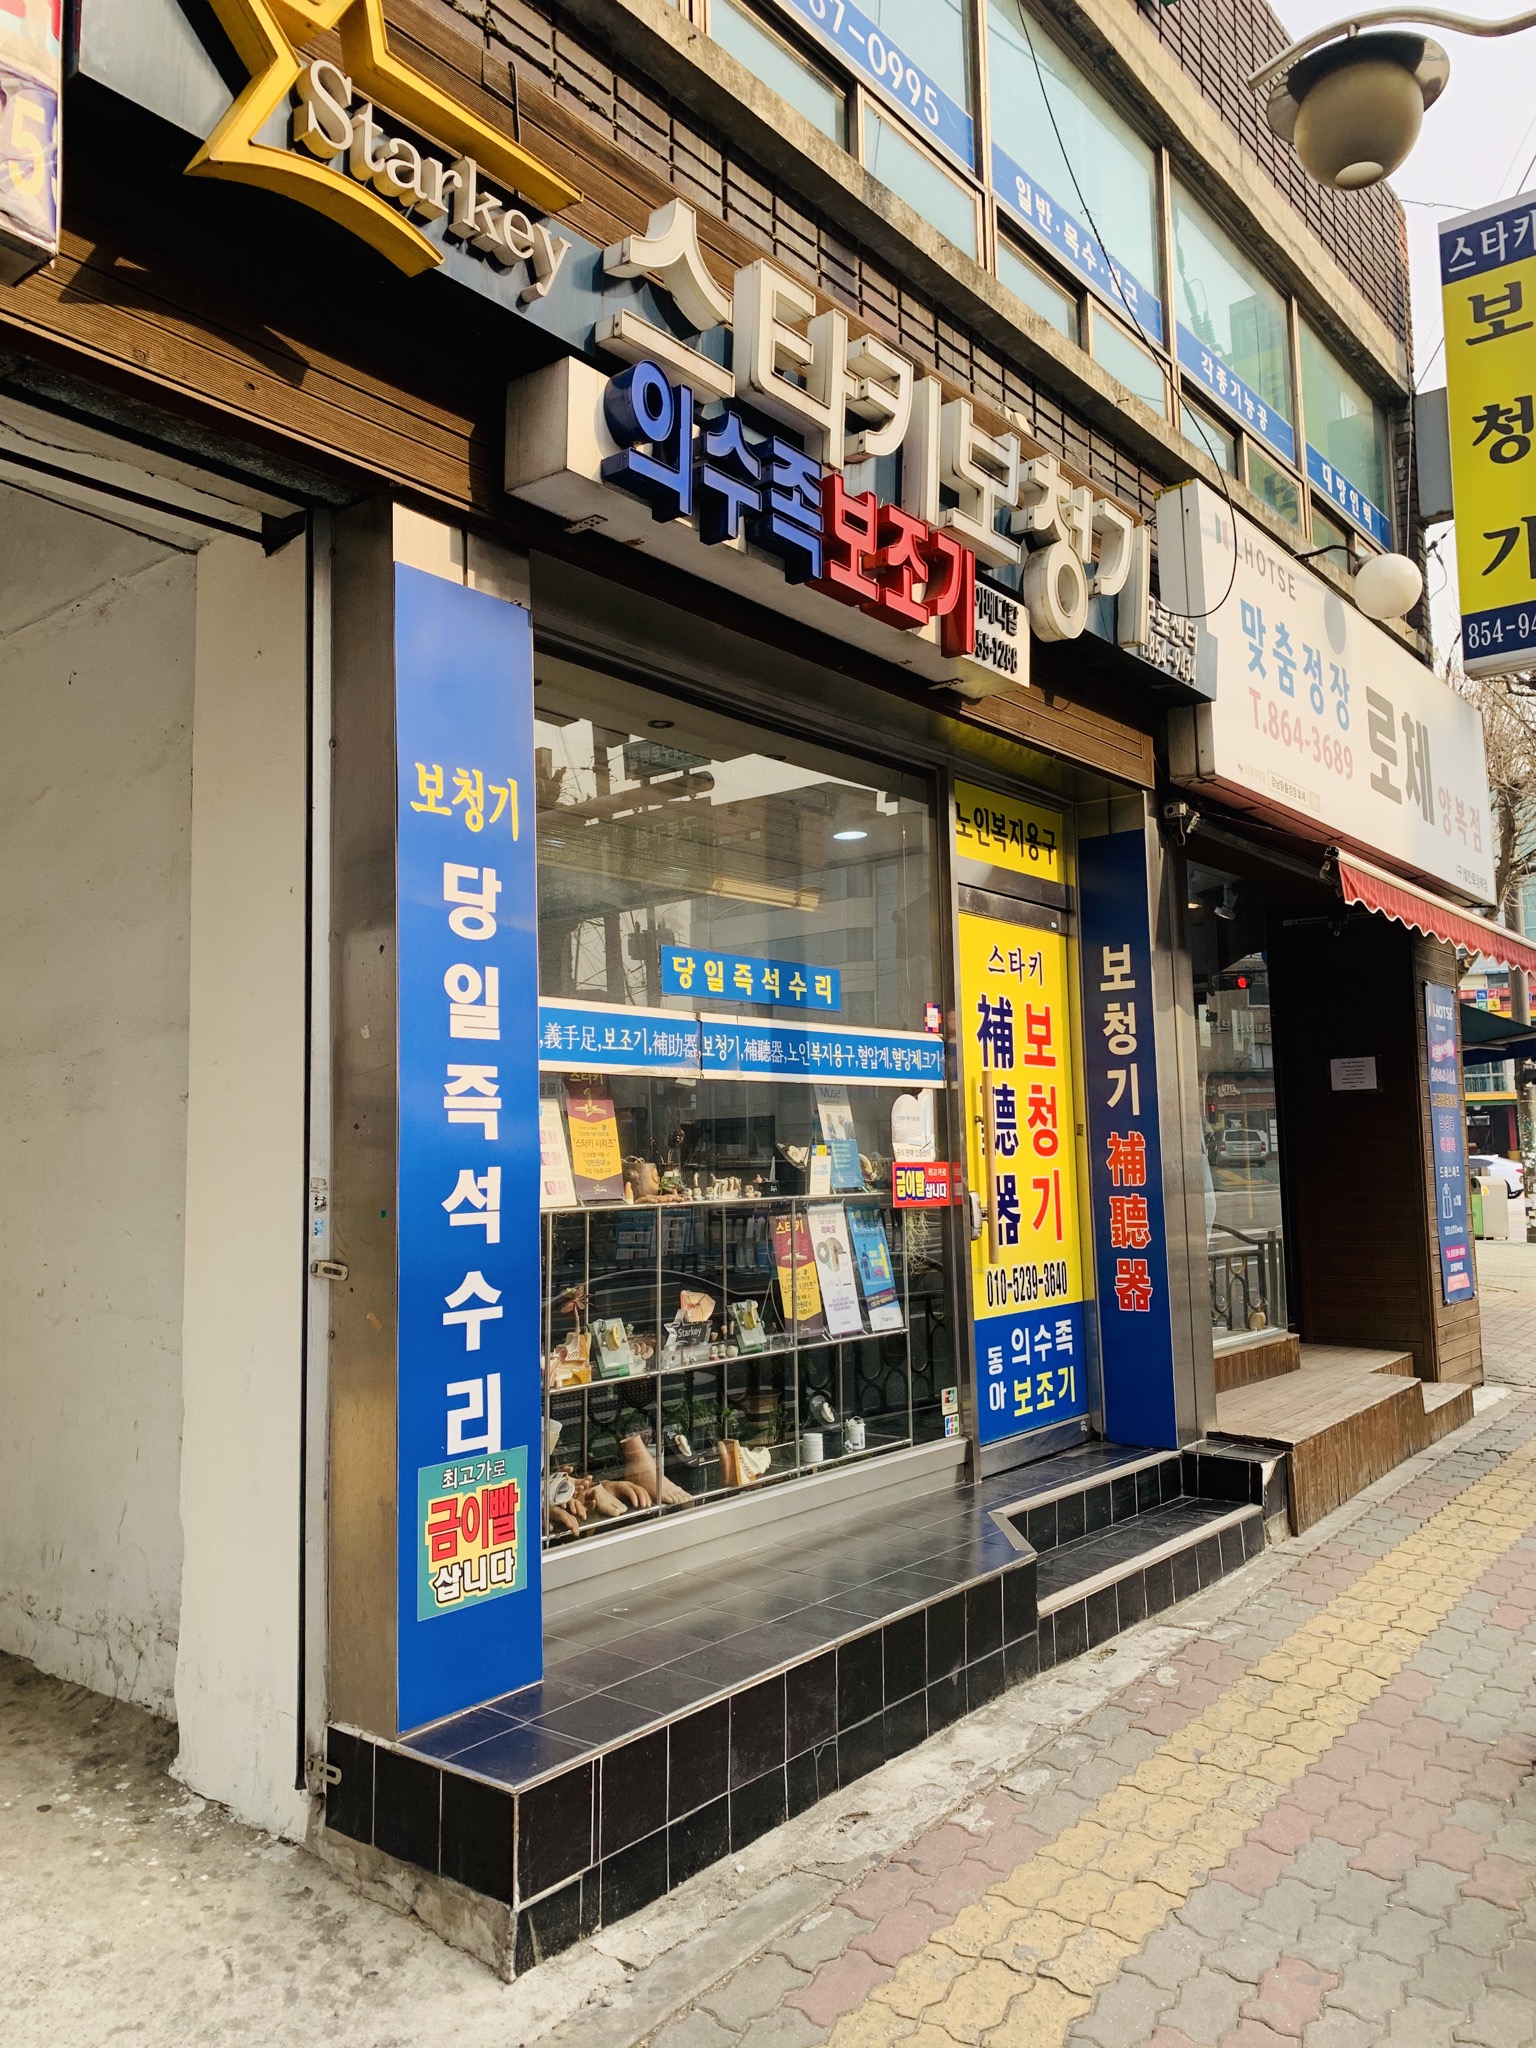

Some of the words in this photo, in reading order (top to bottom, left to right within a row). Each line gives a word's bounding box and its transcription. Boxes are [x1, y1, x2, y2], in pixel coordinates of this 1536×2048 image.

[302, 59, 572, 299] Starkey
[1200, 351, 1269, 432] 각종기능공
[1321, 462, 1373, 531] 대망인력
[1239, 597, 1351, 731] 맞춤정장
[1249, 686, 1355, 782] T.864-3689
[410, 762, 520, 842] 보청기
[1365, 686, 1436, 826] 로체
[1438, 786, 1483, 854] 양복점
[955, 802, 1058, 865] 노인복지용구
[988, 944, 1044, 987] 스타키
[1100, 943, 1141, 1116] 보청기
[820, 1087, 841, 1099] Muse
[1024, 1003, 1063, 1243] 보청기
[442, 862, 503, 1456] 당일즉석수리
[925, 1182, 947, 1198] 삽니다
[987, 1260, 1068, 1308] 010-5239-3640
[677, 1326, 702, 1338] Starkey
[1011, 1319, 1074, 1367] 의수족
[987, 1345, 1007, 1412] 동아
[1013, 1365, 1076, 1418] 보조기
[442, 1458, 507, 1491] 최고가로
[427, 1481, 519, 1563] 금이빨
[434, 1545, 516, 1603] 삽니다
